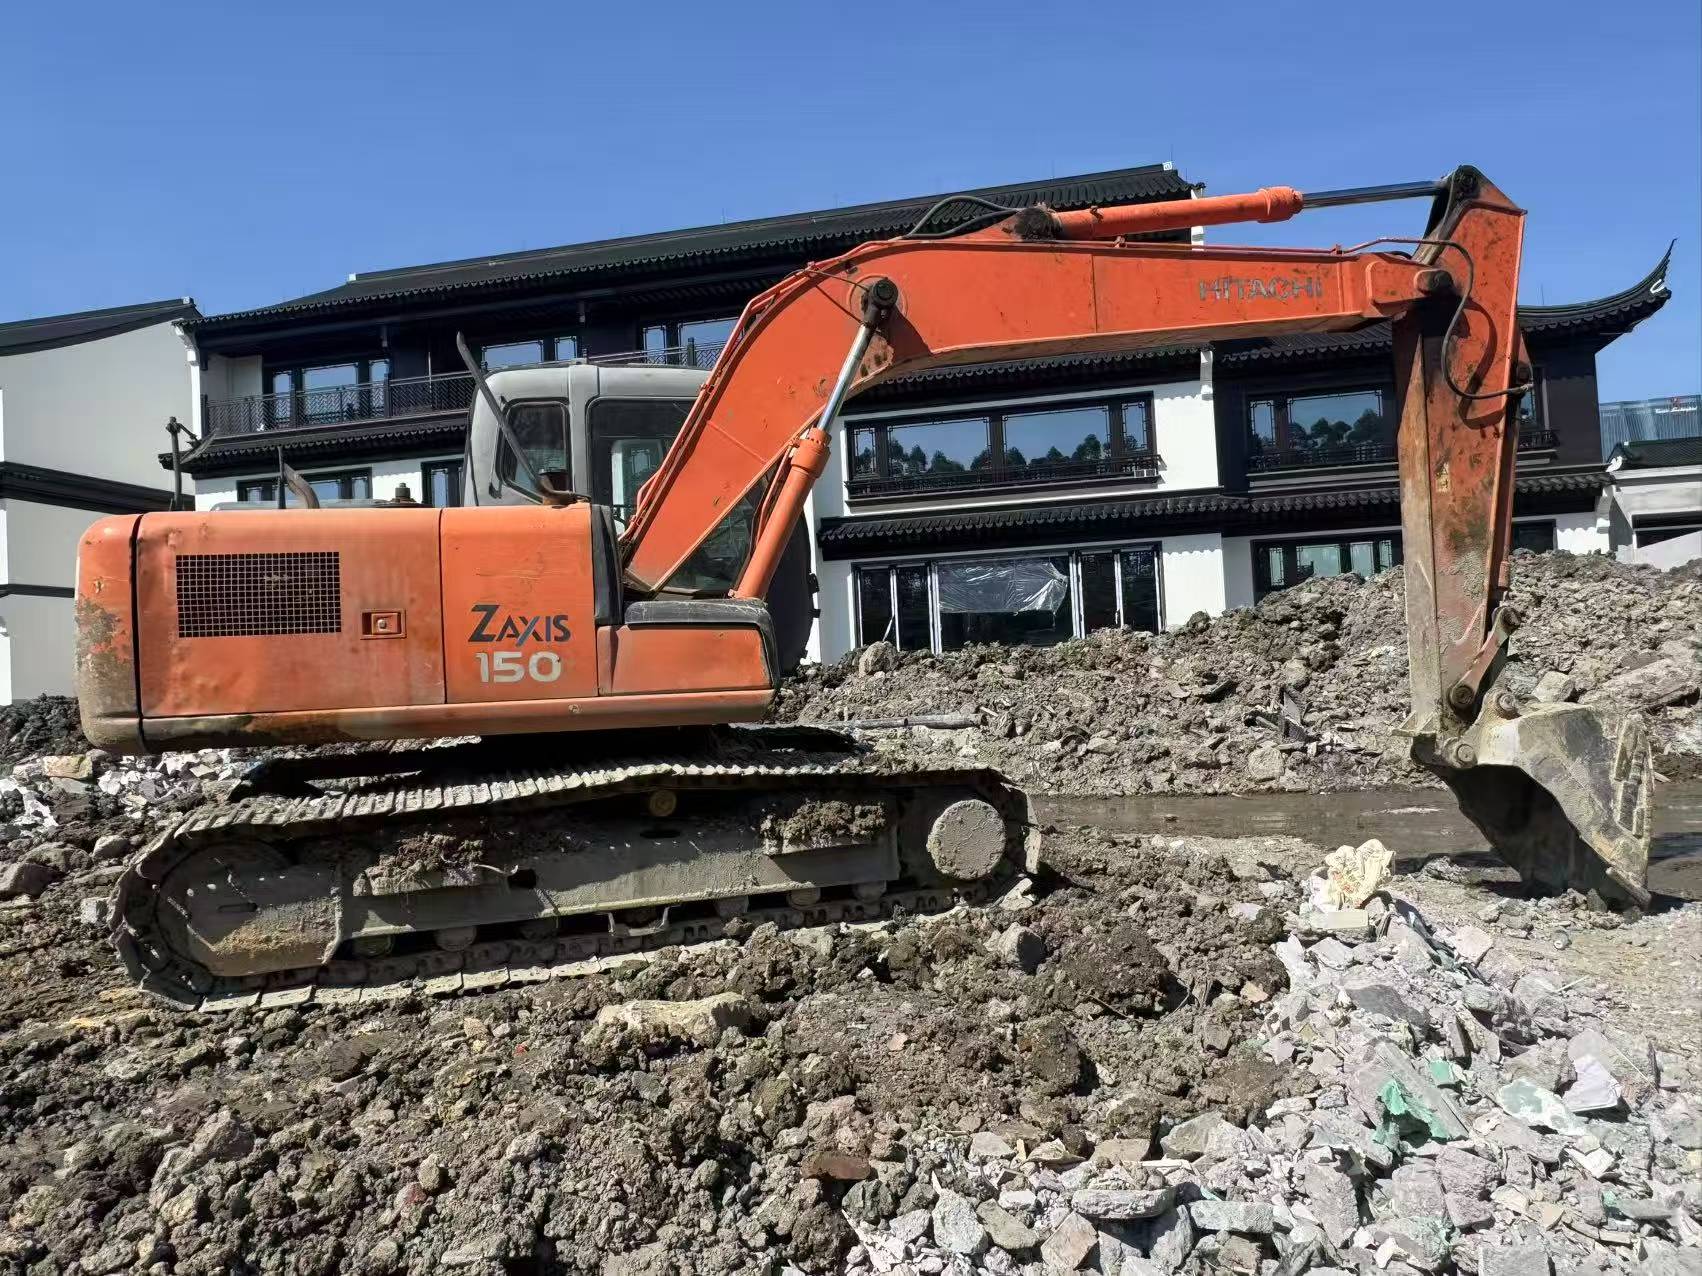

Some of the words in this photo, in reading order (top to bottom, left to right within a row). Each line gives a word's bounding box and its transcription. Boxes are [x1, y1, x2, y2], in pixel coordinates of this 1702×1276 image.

[1199, 276, 1323, 301] HITACHI
[468, 605, 571, 646] ZAXIS
[475, 651, 561, 682] 150
